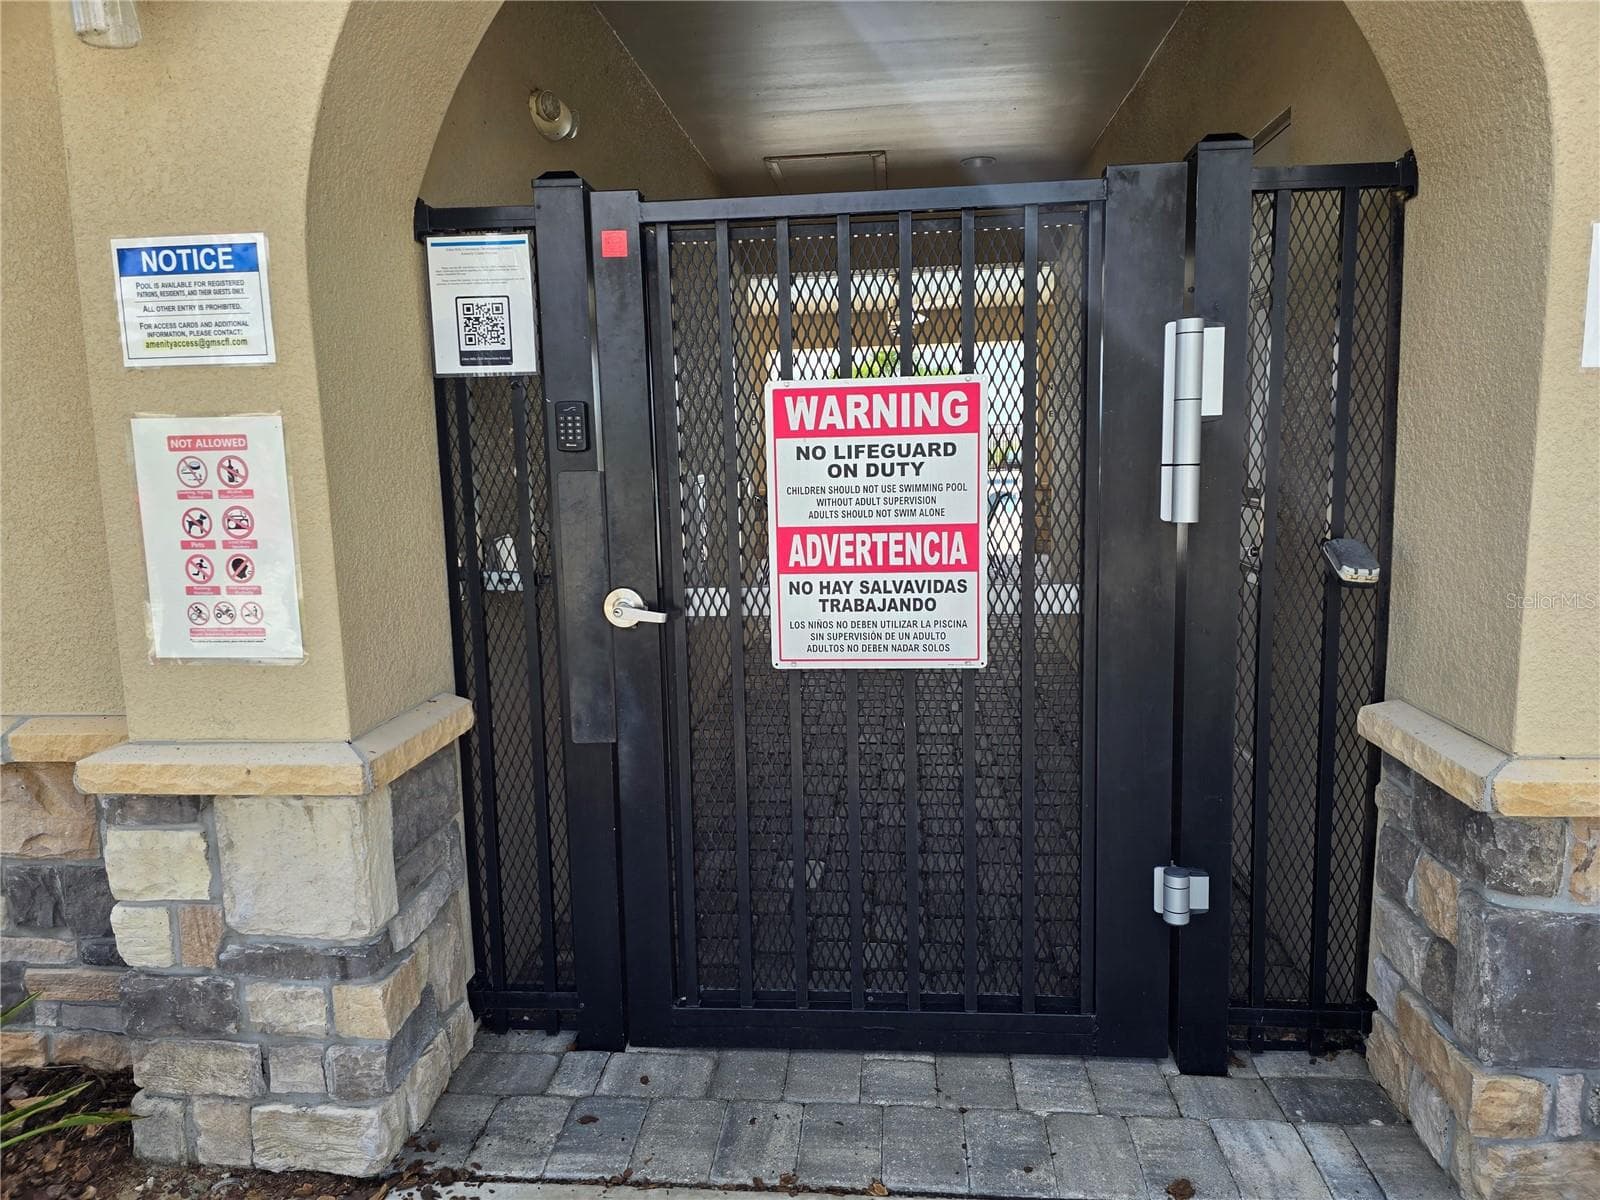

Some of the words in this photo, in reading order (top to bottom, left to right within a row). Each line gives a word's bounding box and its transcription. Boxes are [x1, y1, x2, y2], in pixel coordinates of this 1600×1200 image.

[141, 248, 234, 272] NOTICE
[784, 390, 969, 431] WARNING
[170, 439, 192, 448] NOT
[196, 438, 245, 448] ALLOWED
[796, 445, 826, 460] NO
[834, 442, 957, 460] LIFEGUARD
[827, 463, 857, 478] ON
[866, 462, 925, 477] DUTY
[787, 486, 826, 495] CHILDREN
[828, 485, 860, 494] SHOULD
[863, 485, 880, 493] NOT
[882, 484, 896, 493] USE
[900, 483, 943, 492] SWIMMING
[946, 483, 967, 491] POOL
[817, 498, 853, 506] WITHOUT
[855, 497, 880, 506] ADULT
[883, 496, 936, 505] SUPERVISION
[809, 510, 839, 519] ADULTS
[842, 510, 874, 518] SHOULD
[876, 509, 892, 518] NOT
[894, 509, 916, 517] SWIM
[919, 508, 945, 516] ALONE
[789, 531, 968, 567] ADVERTENCIA
[789, 581, 813, 595] NO
[819, 580, 854, 595] HAY
[860, 579, 968, 594] SALVAVIDAS
[819, 598, 936, 612] TRABAJANDO
[790, 621, 805, 629] LOS
[808, 619, 833, 629] NIÑOS
[836, 620, 848, 629] NO
[851, 620, 878, 629] DEBEN
[880, 620, 918, 628] UTILIZAR
[921, 620, 931, 628] LA
[934, 619, 968, 628] PISCINA
[810, 632, 824, 641] SIN
[827, 631, 882, 641] SUPERVISIÓN
[885, 632, 895, 640] DE
[898, 632, 910, 640] UN
[913, 632, 946, 640] ADULTO
[807, 644, 844, 653] ADULTOS
[847, 644, 858, 652] NO
[862, 644, 888, 652] DEBEN
[891, 644, 919, 652] NADAR
[922, 643, 950, 652] SOLOS
